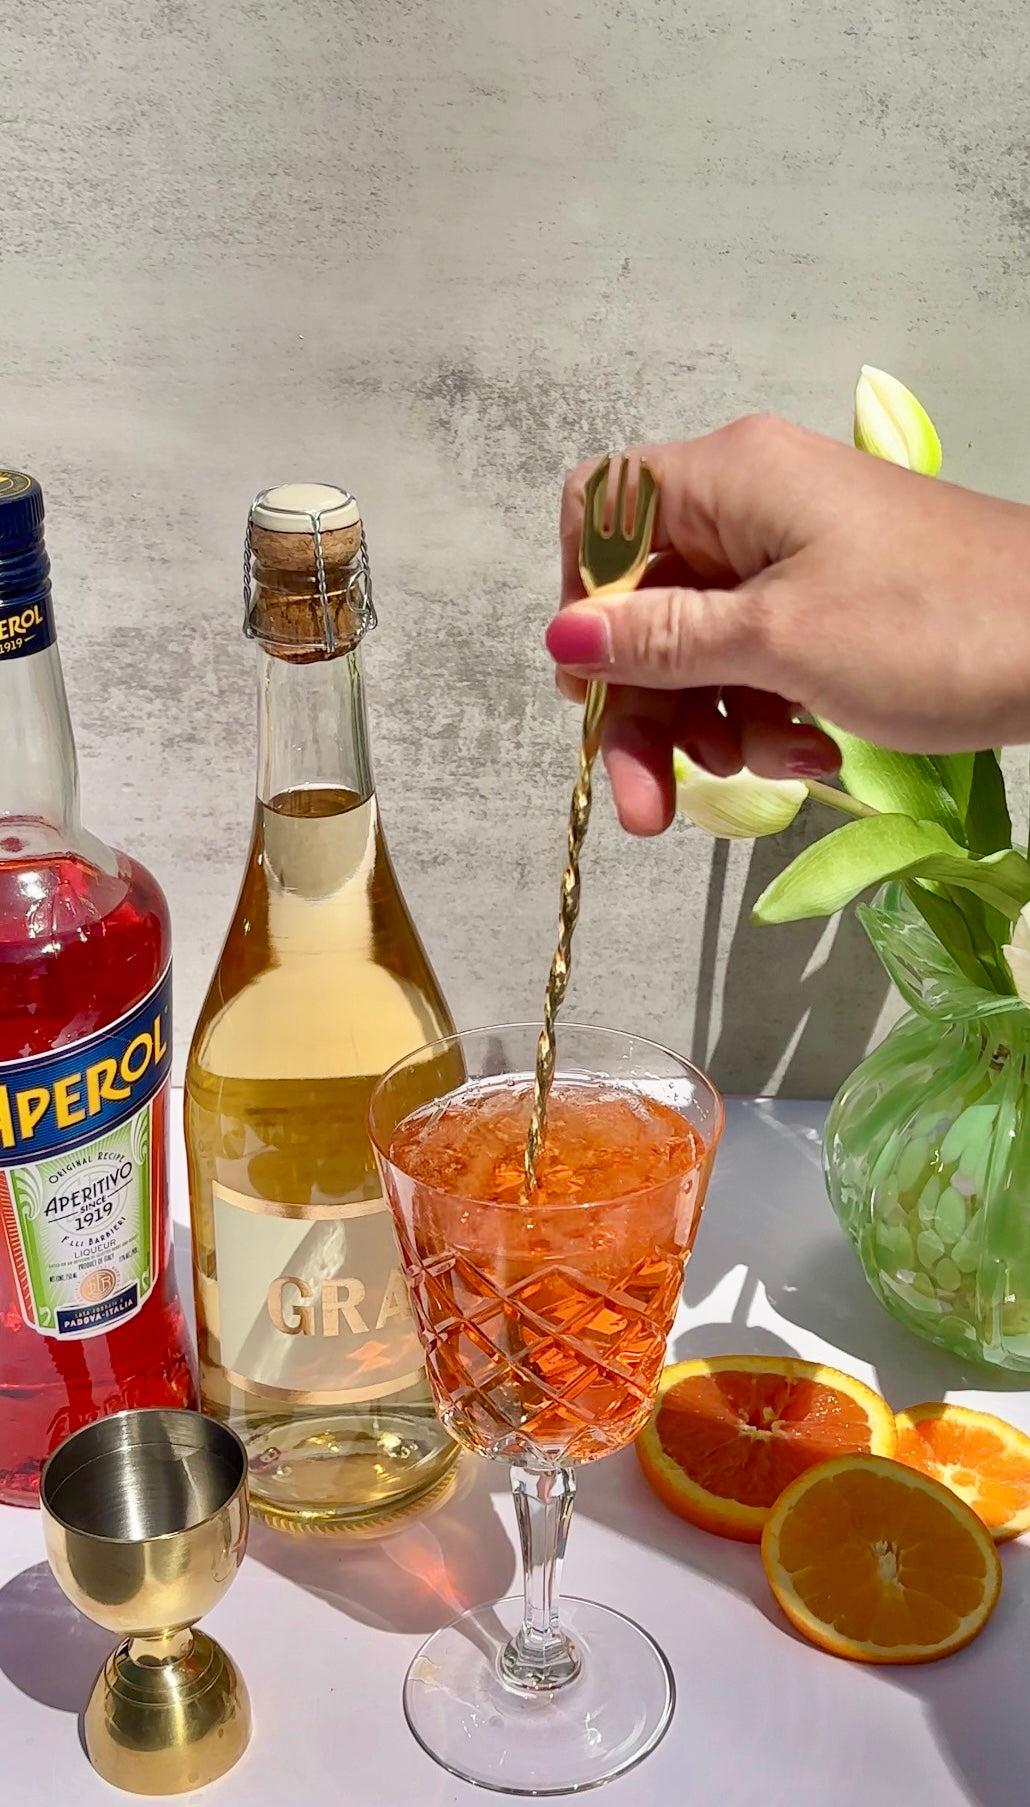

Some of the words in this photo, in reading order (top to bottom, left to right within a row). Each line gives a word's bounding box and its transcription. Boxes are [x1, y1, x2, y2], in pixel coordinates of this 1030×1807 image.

[48, 1155, 92, 1184] ORIGINAL
[97, 1151, 125, 1163] RECIPE
[43, 1161, 133, 1217] APERITIVO
[74, 1202, 113, 1231] 1919
[80, 1195, 107, 1214] SINCE
[88, 1216, 127, 1246] BARBIERI
[74, 1238, 117, 1259] LIQUEUR
